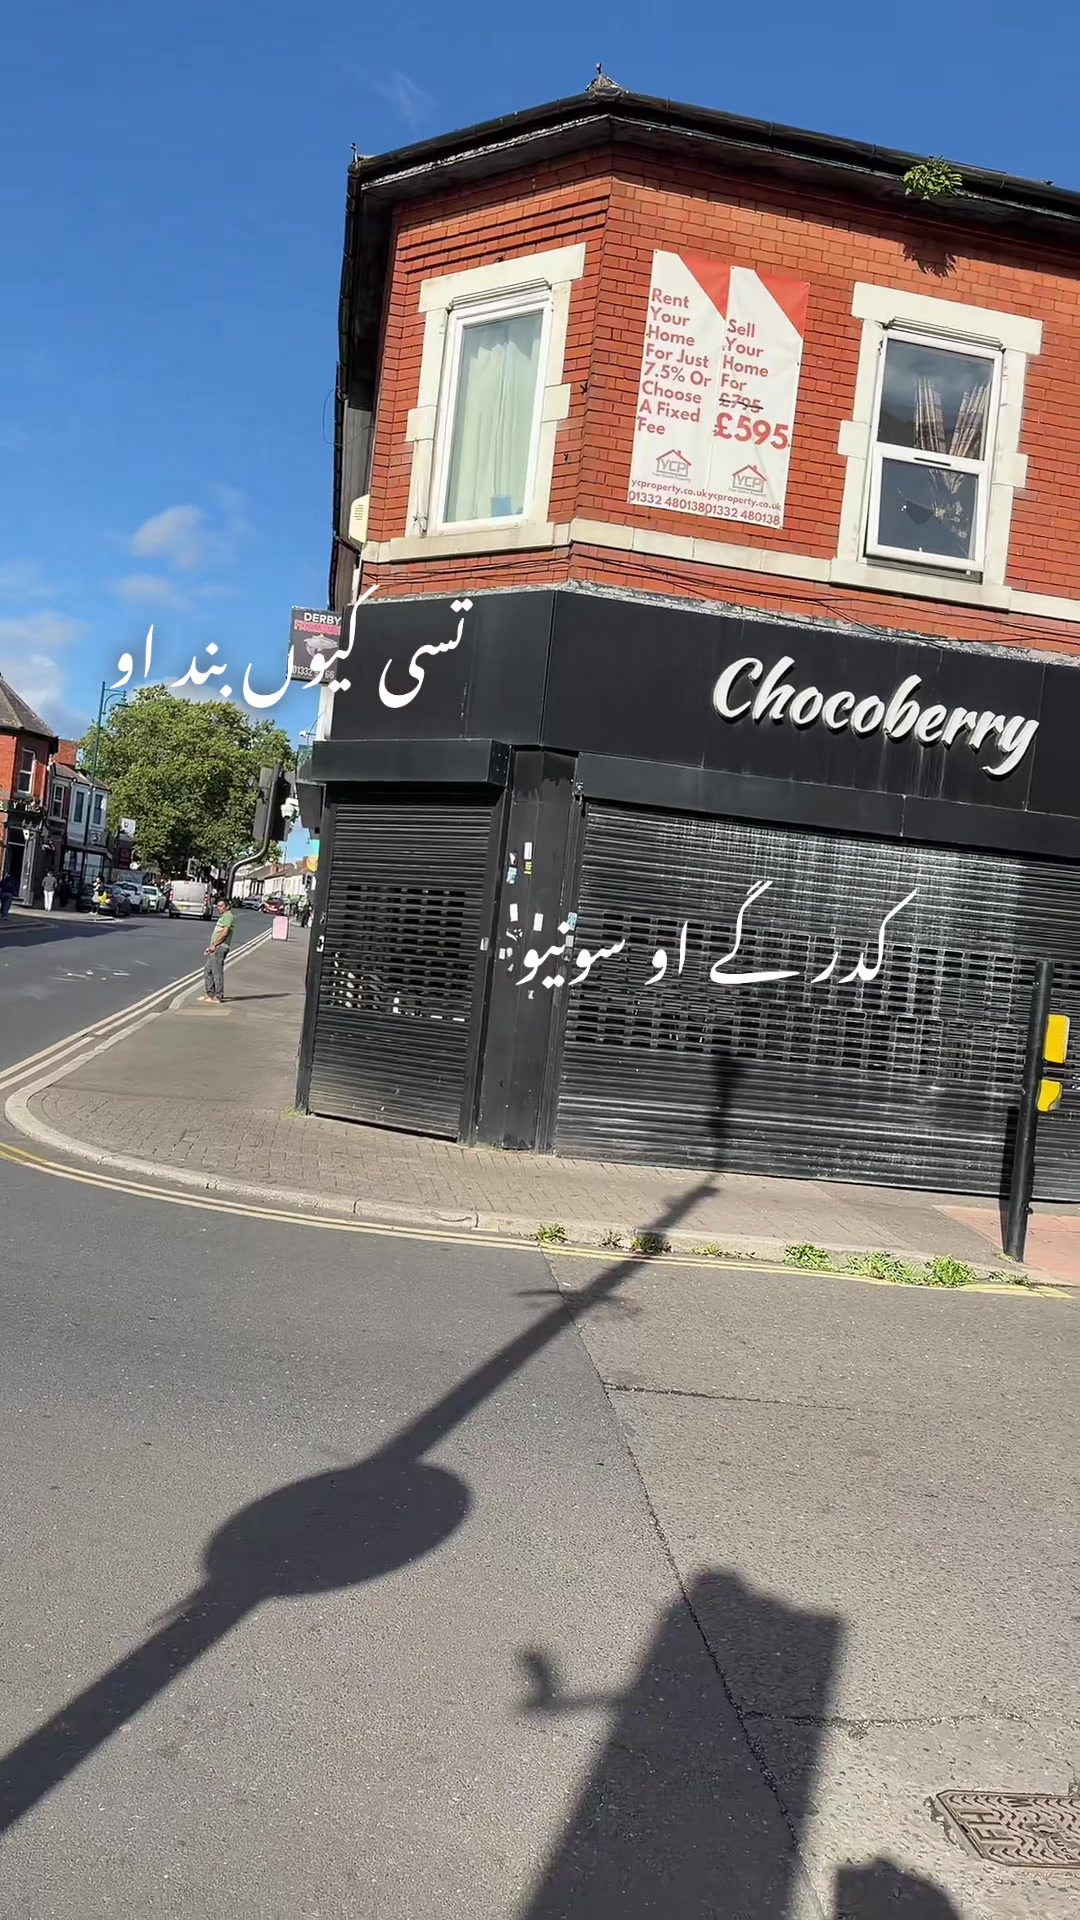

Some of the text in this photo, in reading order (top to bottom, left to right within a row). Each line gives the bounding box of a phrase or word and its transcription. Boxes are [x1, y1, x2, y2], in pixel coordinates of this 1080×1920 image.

[651, 288, 690, 309] Rent
[650, 306, 690, 327] Your
[648, 324, 696, 347] Home
[727, 319, 756, 338] Sell
[645, 343, 710, 369] For Just
[725, 336, 764, 358] Your
[643, 361, 712, 388] 7.5% Or
[722, 354, 769, 378] Home
[641, 380, 702, 404] Choose
[720, 373, 748, 391] For
[639, 398, 701, 423] A Fixed
[719, 392, 763, 414] £795
[637, 415, 666, 435] Fee
[714, 412, 789, 450] £595
[661, 459, 686, 473] YCP
[631, 478, 707, 498] ycproperty.co.uk
[737, 474, 762, 489] YCP
[628, 490, 706, 513] 01332 480138
[708, 490, 782, 511] ycproperty.co.uk
[705, 503, 781, 526] 01332 480138
[303, 612, 342, 626] DERBY
[712, 655, 1040, 781] Chocoberry
